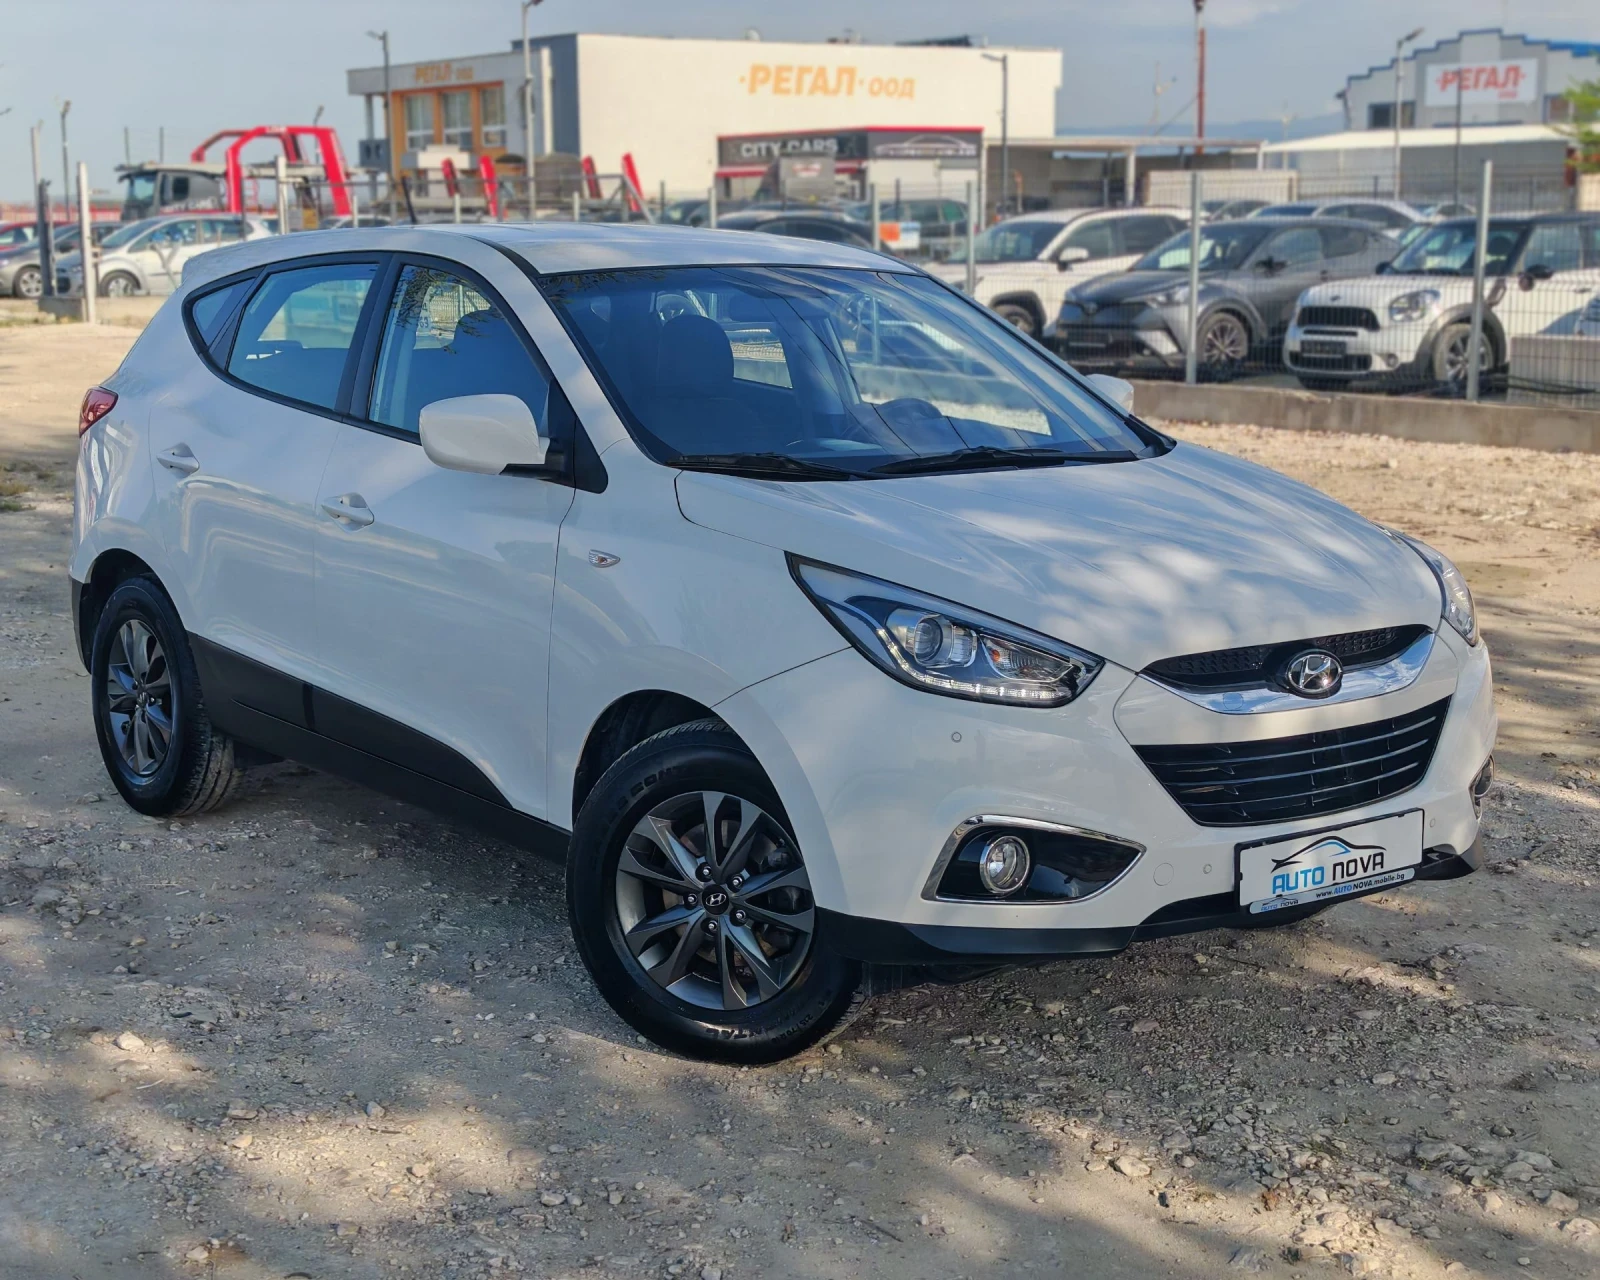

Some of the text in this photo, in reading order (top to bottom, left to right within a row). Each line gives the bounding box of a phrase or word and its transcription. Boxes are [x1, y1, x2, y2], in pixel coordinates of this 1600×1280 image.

[741, 137, 838, 158] CITY CARS
[1272, 866, 1325, 895] AUTO
